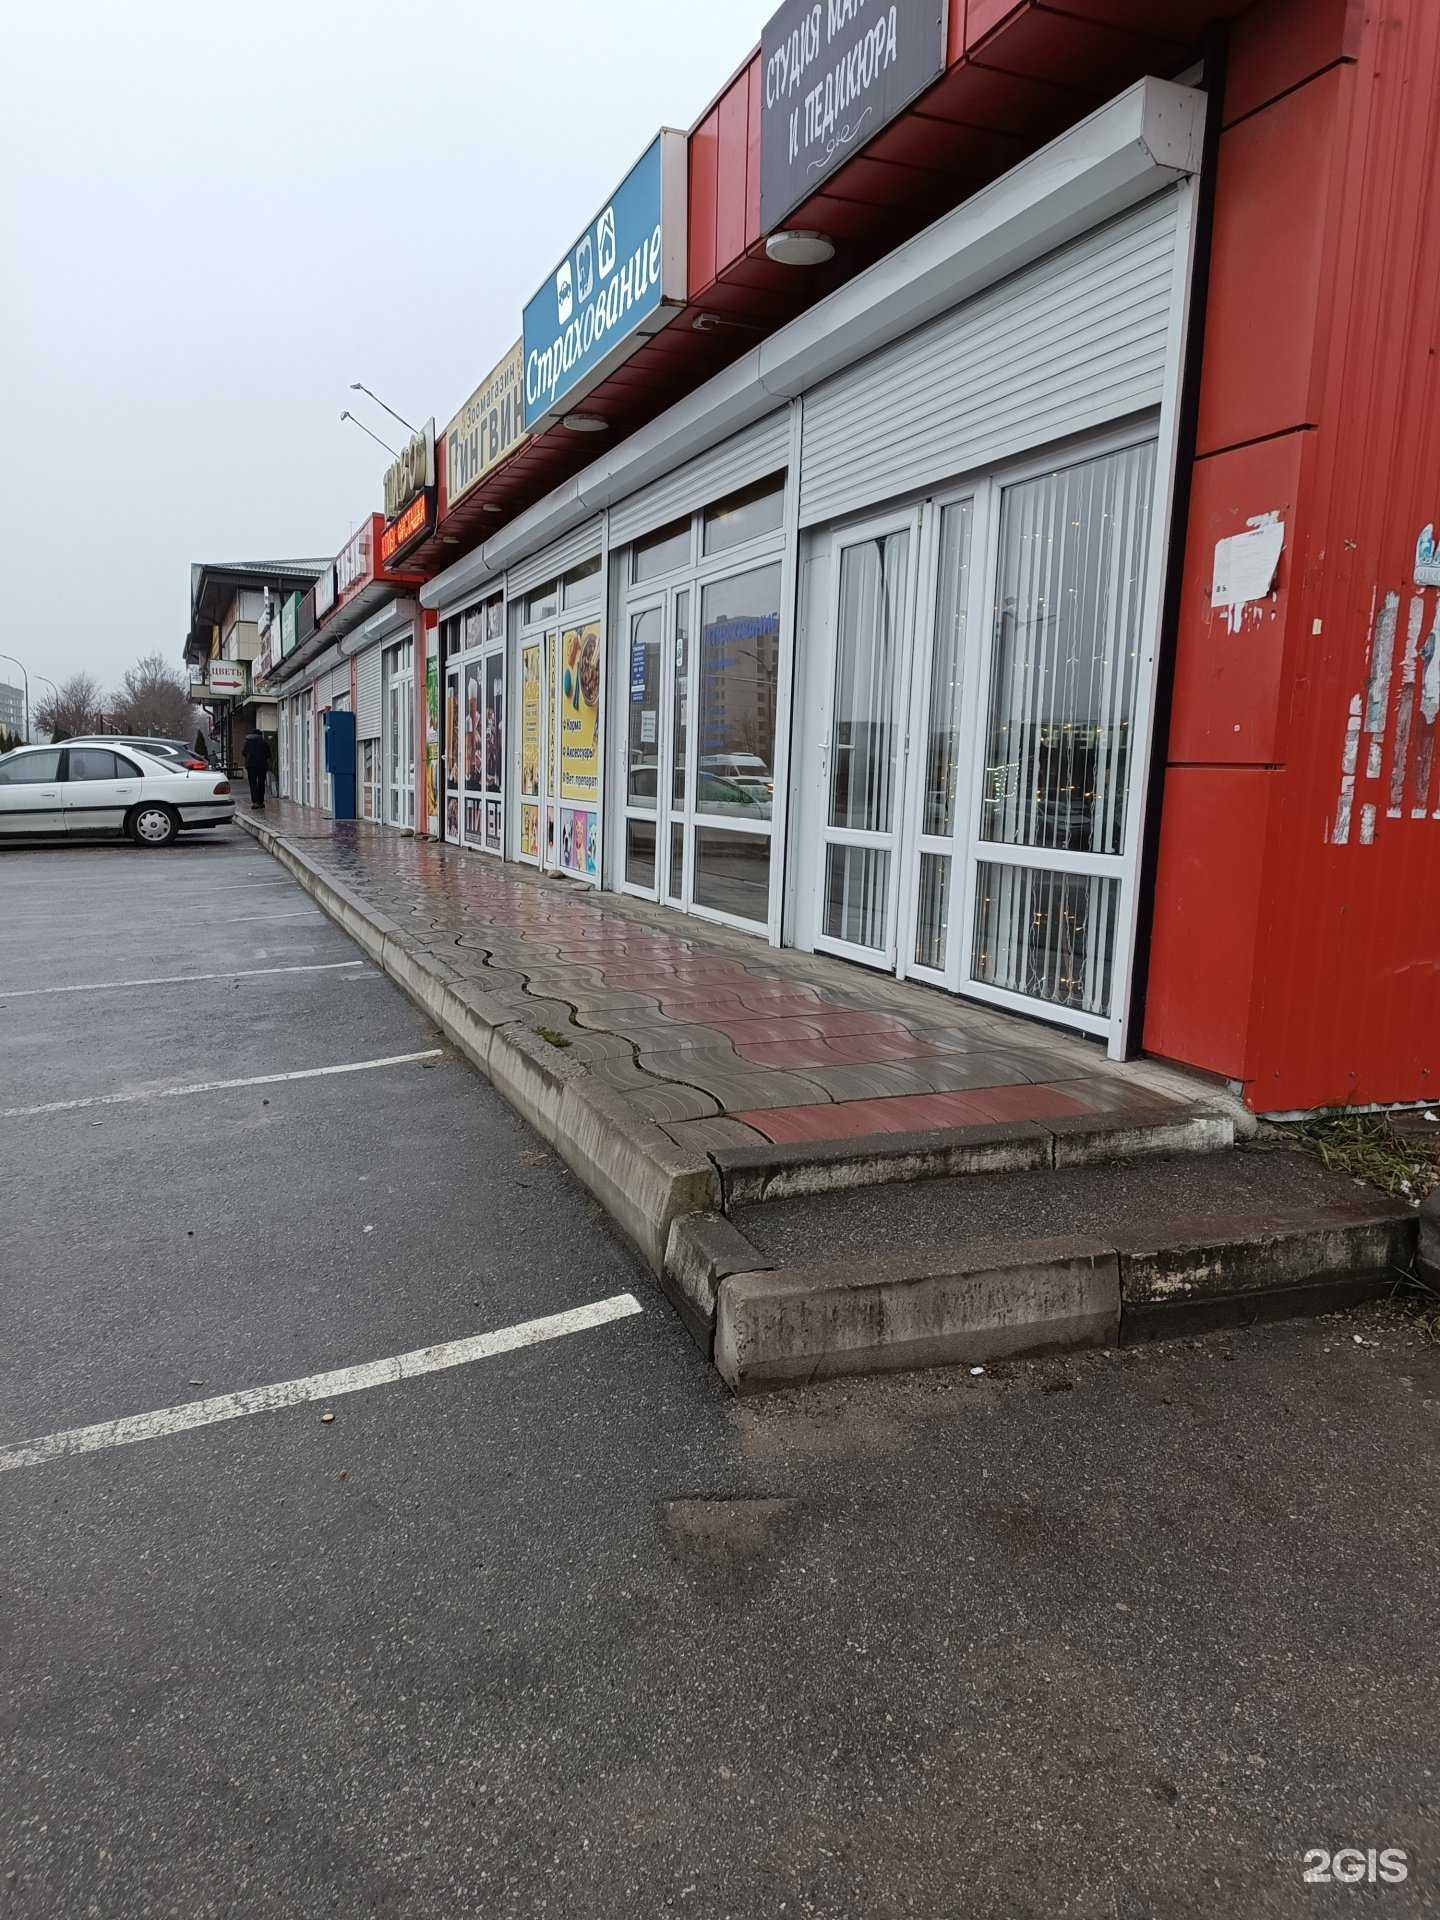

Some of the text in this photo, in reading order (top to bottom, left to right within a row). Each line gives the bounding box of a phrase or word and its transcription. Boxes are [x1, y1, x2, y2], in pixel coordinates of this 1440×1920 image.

[766, 3, 822, 110] СТУДИЯ
[788, 4, 897, 166] И ПЕДИКЮРА
[526, 223, 661, 406] Страхование
[466, 362, 515, 429] Зоомагазин
[210, 667, 245, 678] ЦВЕТЫ
